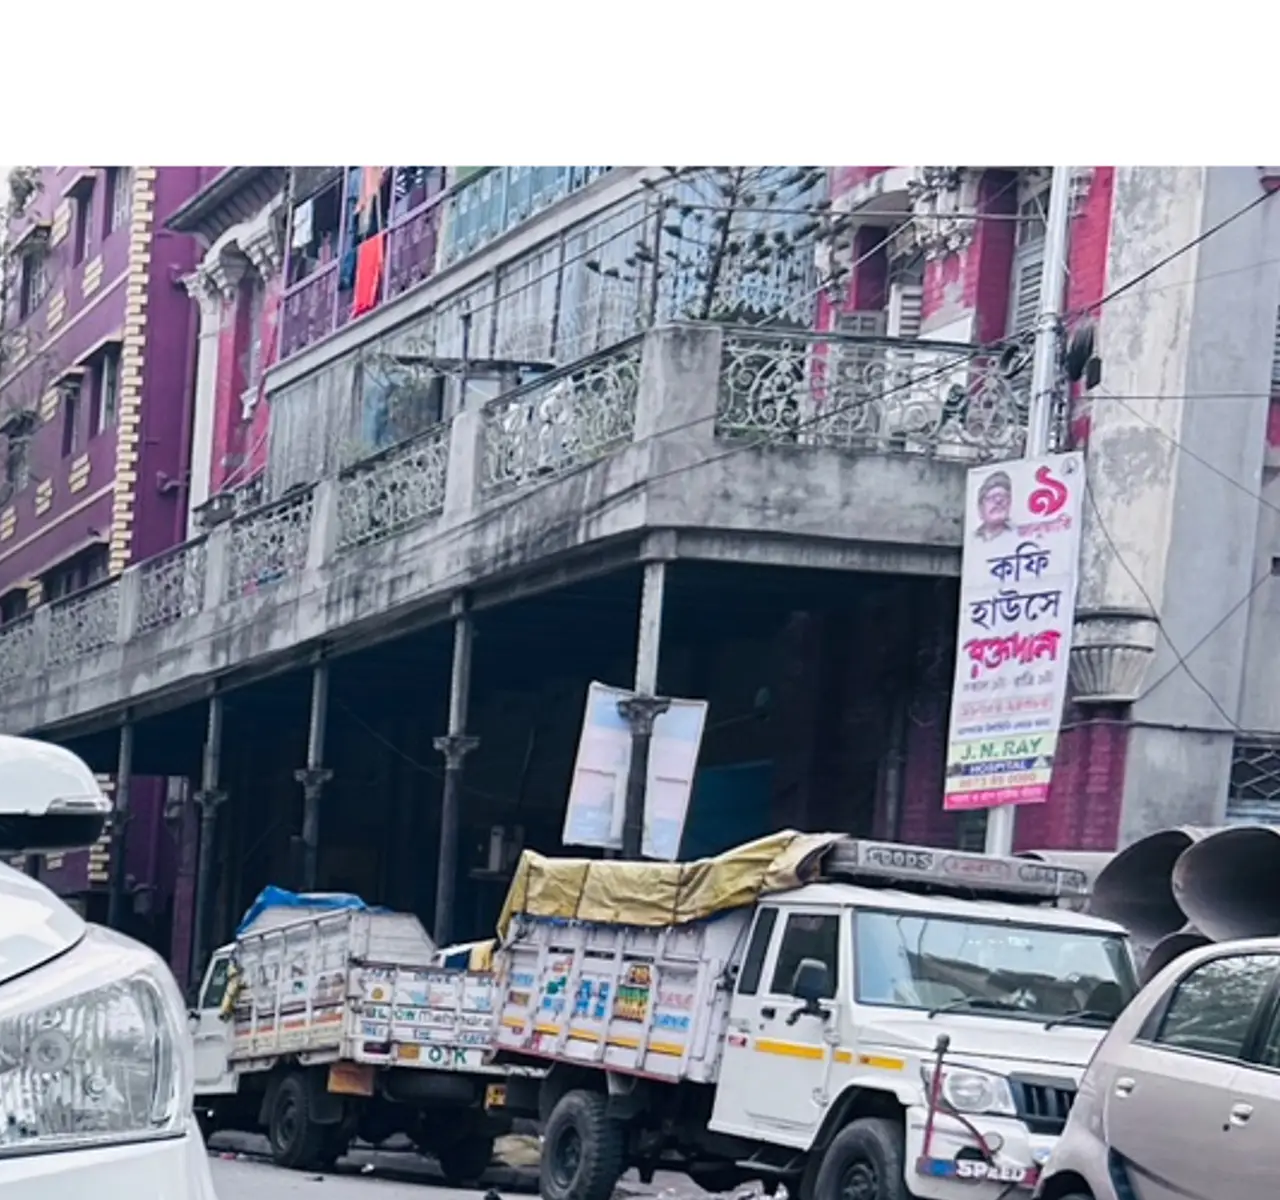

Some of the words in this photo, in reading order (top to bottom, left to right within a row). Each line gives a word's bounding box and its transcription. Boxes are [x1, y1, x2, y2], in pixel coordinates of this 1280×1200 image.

[1028, 465, 1068, 517] ৯
[986, 541, 1051, 582] কফি
[969, 590, 1062, 629] হাউসে
[963, 630, 1062, 679] রক্তদান
[970, 760, 1025, 773] HOSPITAL
